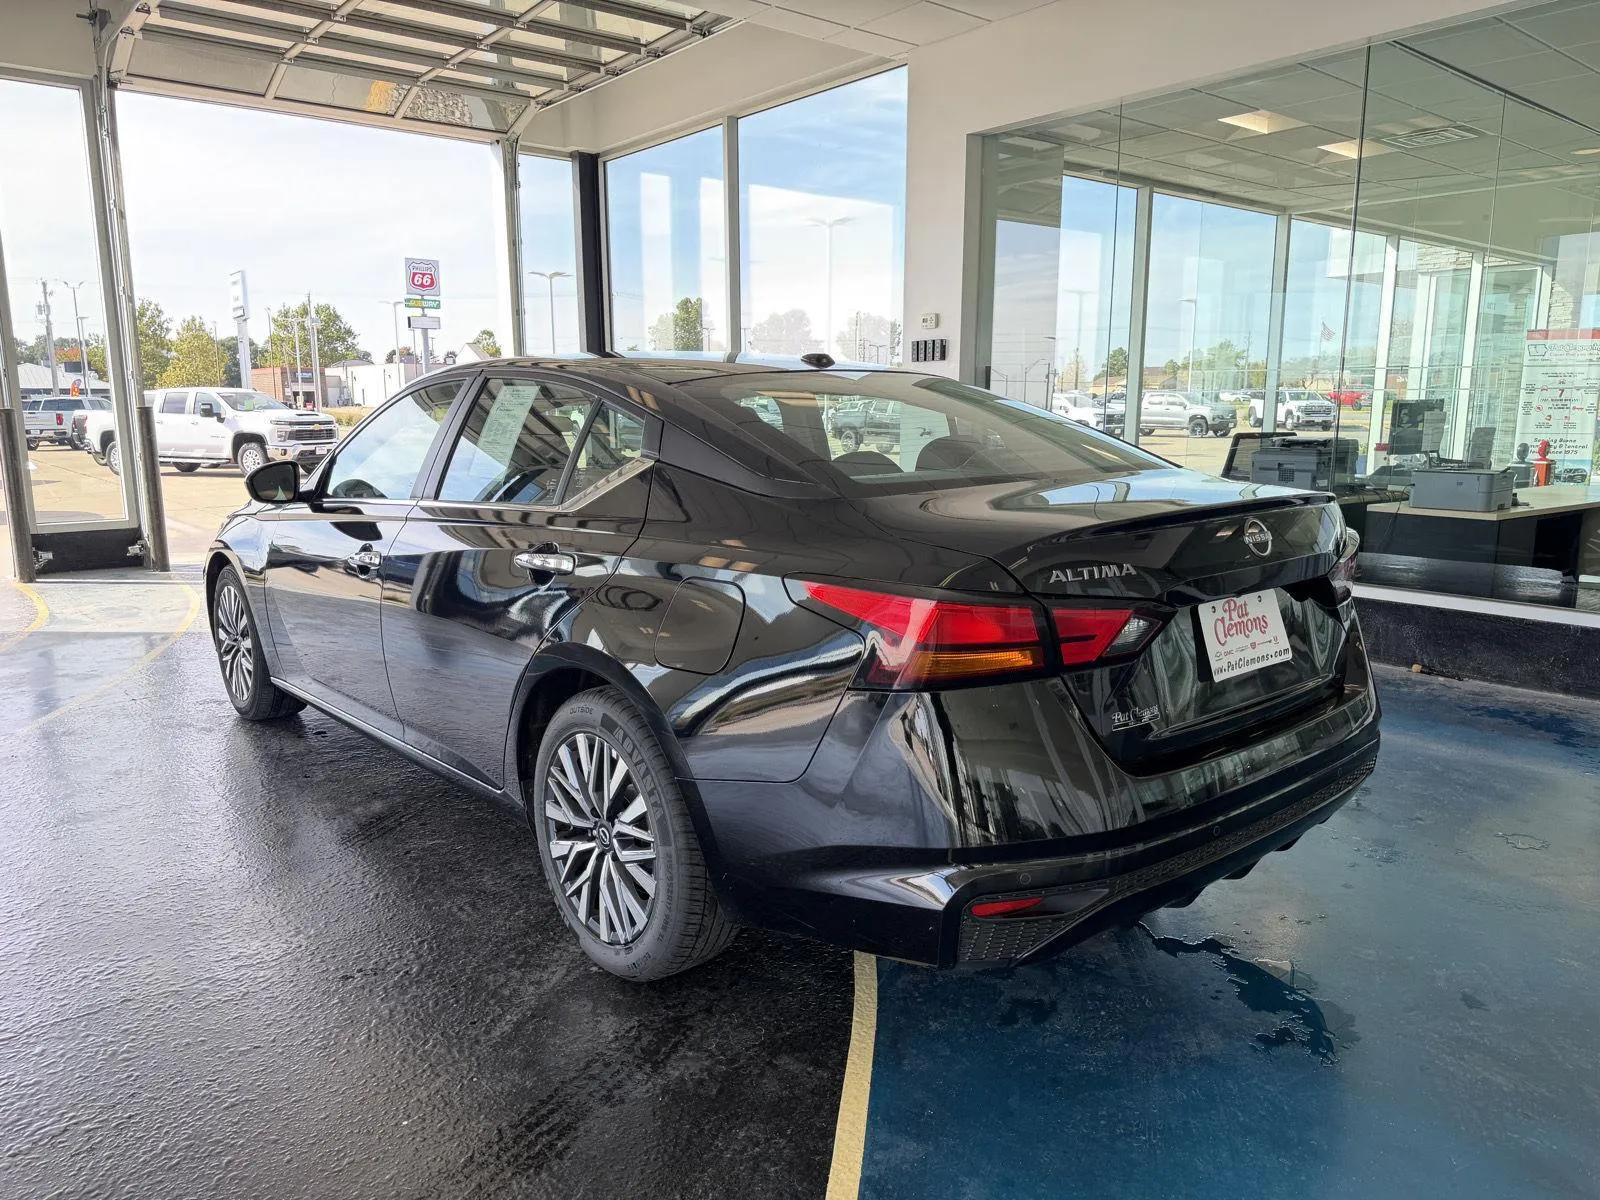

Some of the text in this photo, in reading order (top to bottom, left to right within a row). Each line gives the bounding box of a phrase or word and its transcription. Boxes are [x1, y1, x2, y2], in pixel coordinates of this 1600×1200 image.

[414, 273, 432, 286] 66
[1049, 563, 1137, 584] ALTIMA
[1222, 597, 1250, 622] Pat
[1213, 614, 1268, 647] Clemons
[569, 705, 595, 716] OUTSIDE
